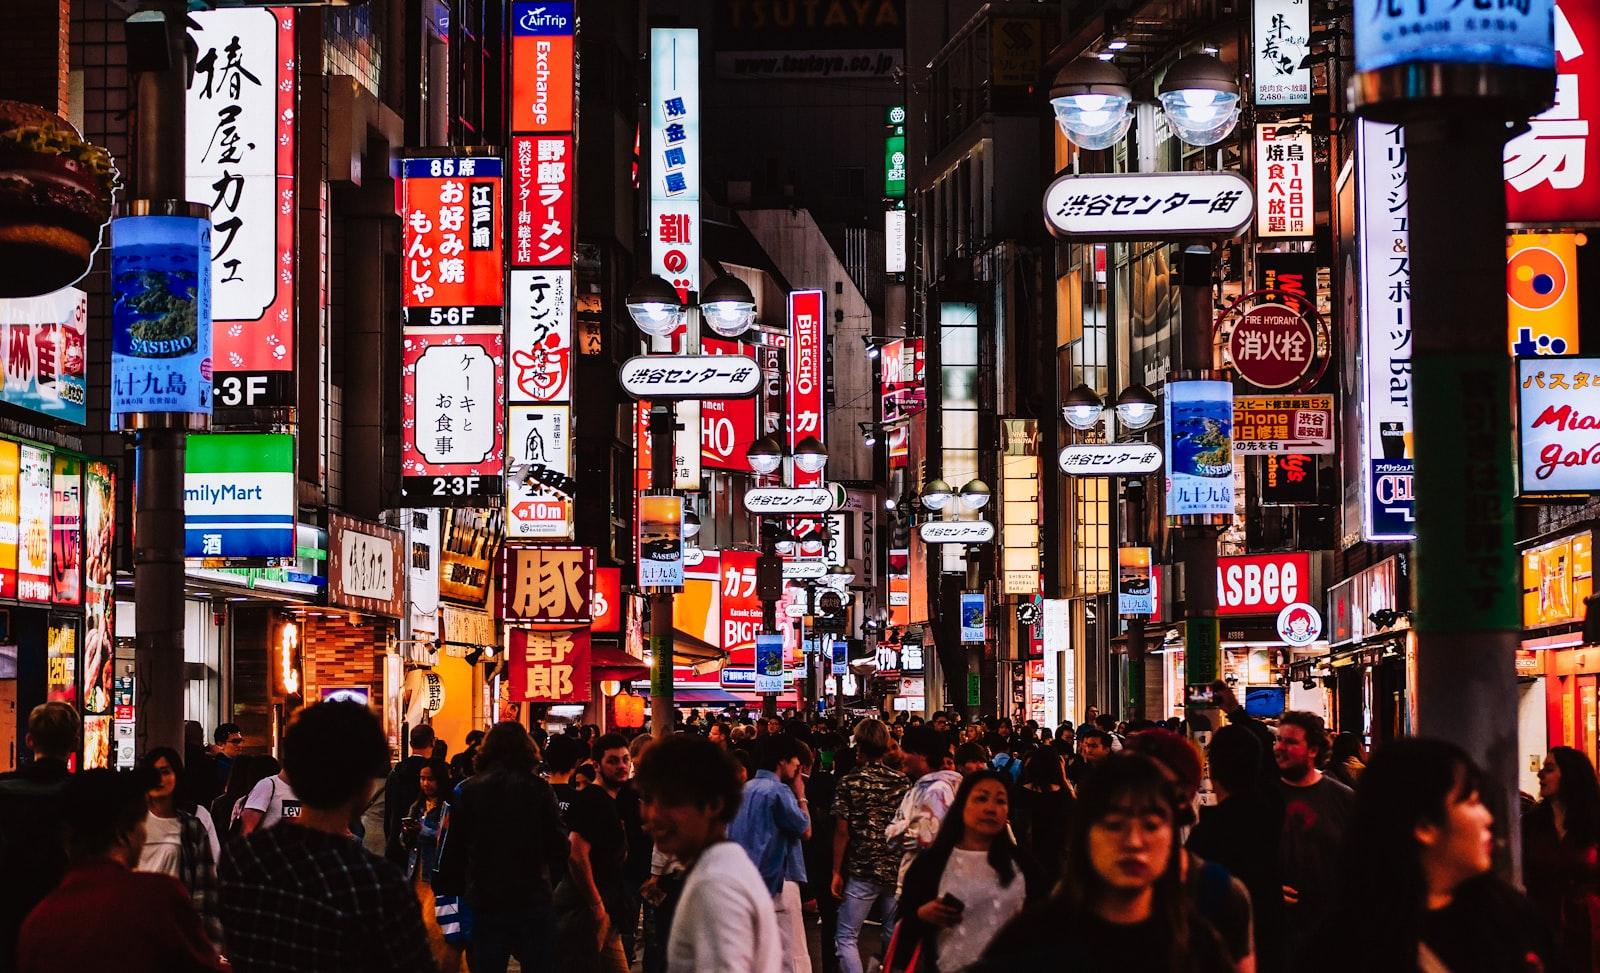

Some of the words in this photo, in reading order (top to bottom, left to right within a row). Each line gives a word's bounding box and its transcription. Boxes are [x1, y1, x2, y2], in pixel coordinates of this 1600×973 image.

[528, 14, 567, 28] AirTrip
[734, 52, 893, 75] www.tsutaya.co.jp
[532, 41, 551, 125] Exchange
[664, 97, 687, 193] 現金問屋
[196, 36, 262, 283] 椿屋カフェ
[430, 159, 476, 177] 85席
[537, 139, 566, 263] 野郎ラーメン
[1056, 190, 1244, 216] 渋谷センター街
[472, 186, 491, 248] 江戸前
[438, 181, 465, 284] お好み焼
[408, 210, 435, 303] もんじゃ
[797, 314, 812, 346] BIG
[1245, 315, 1261, 325] FIRE
[1263, 316, 1299, 325] HYDRANT
[130, 335, 193, 355] SASEBO
[1238, 329, 1306, 361] 消火栓
[628, 367, 753, 384] 渋谷センター街
[797, 350, 813, 395] ECHO
[459, 353, 476, 432] ケーキと
[434, 393, 454, 455] お食事
[1233, 412, 1288, 425] Phone
[1298, 413, 1324, 426] 渋谷
[1064, 452, 1157, 465] 渋谷センター街
[1195, 463, 1232, 476] SASEBO
[748, 495, 828, 505] 渋谷センター街
[1177, 486, 1231, 503] 九十九島
[924, 526, 989, 537] 渋谷センター街
[202, 534, 222, 555] 酒
[651, 551, 680, 561] SASEBO
[512, 550, 585, 617] 豚
[642, 567, 678, 579] 九十九島
[1121, 599, 1148, 609] 九十九島
[725, 620, 751, 648] BIG
[525, 631, 574, 700] 野郎
